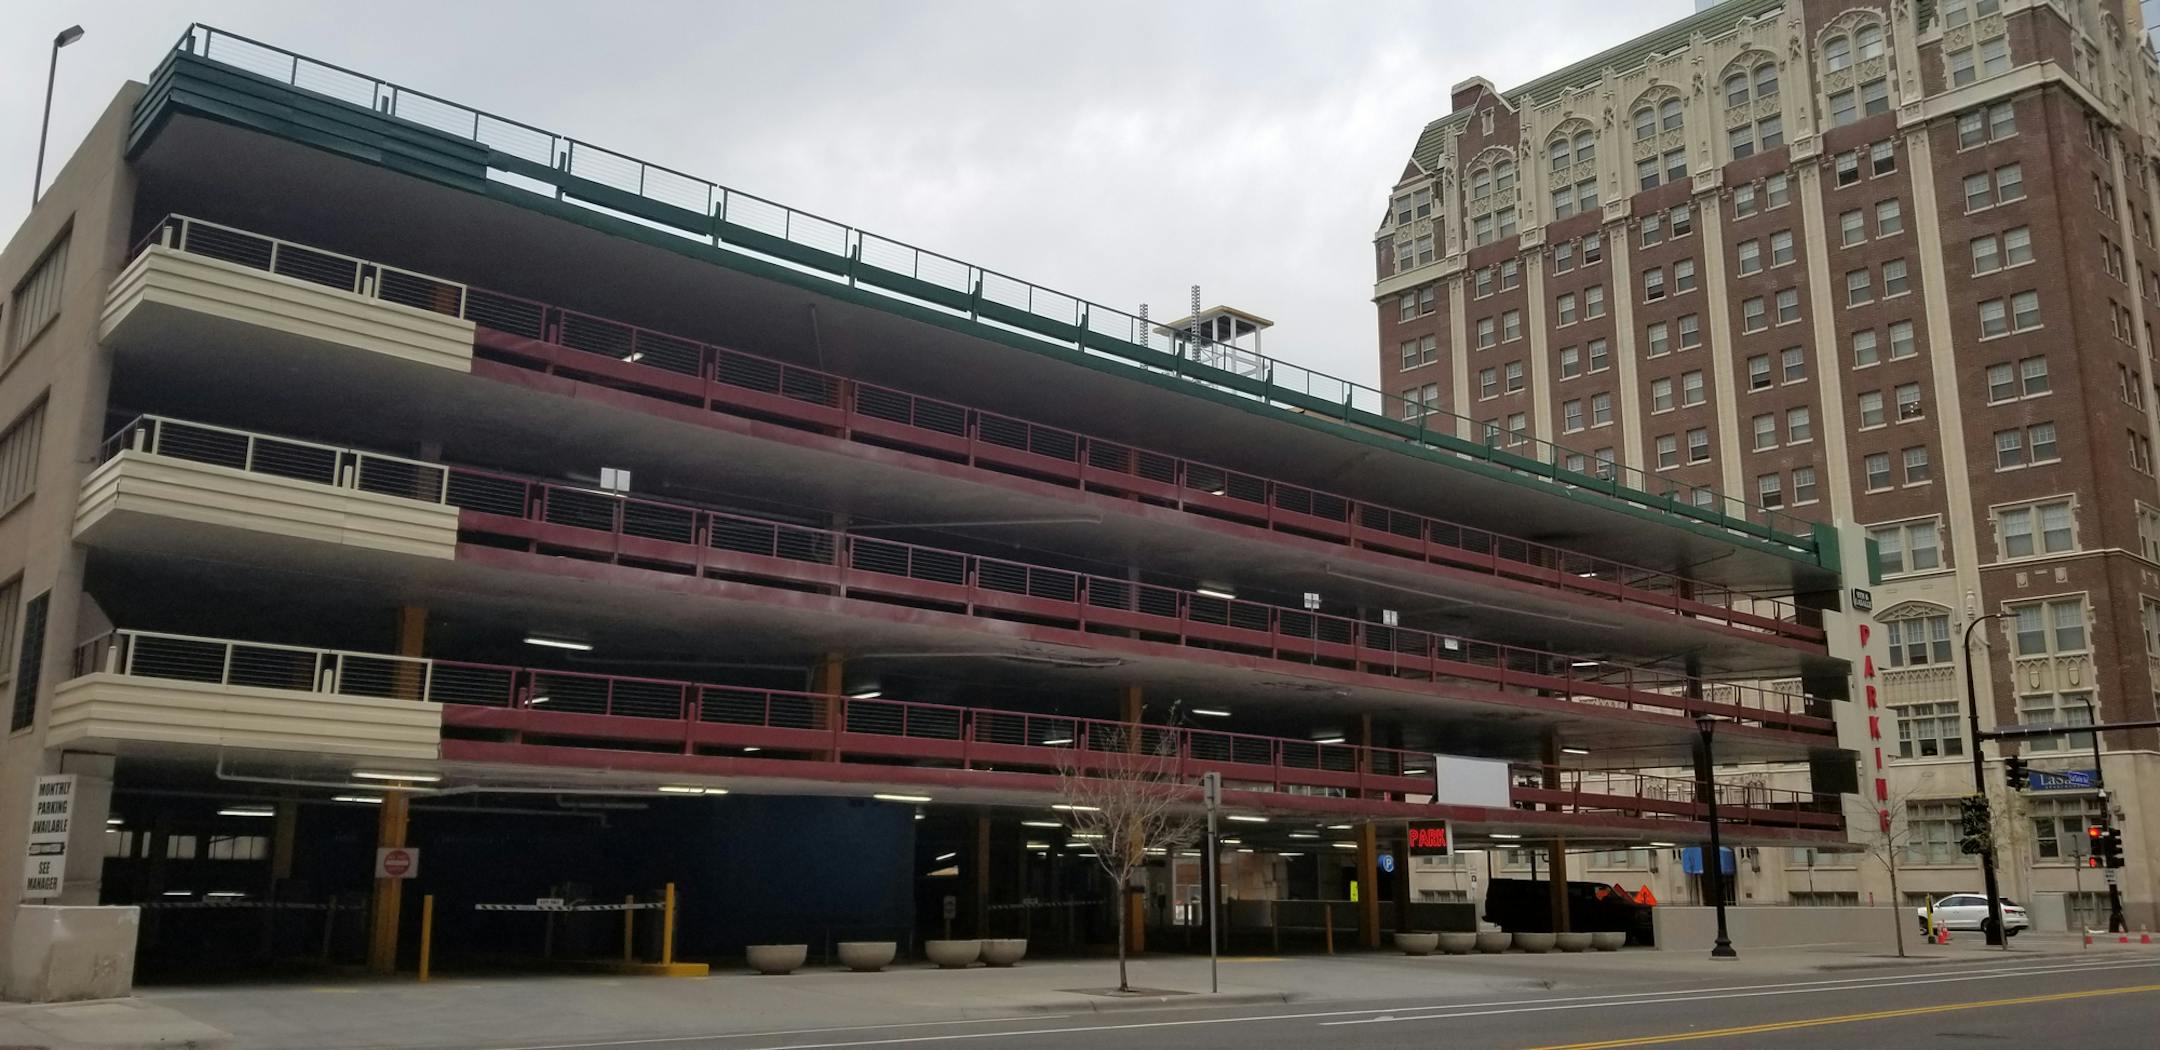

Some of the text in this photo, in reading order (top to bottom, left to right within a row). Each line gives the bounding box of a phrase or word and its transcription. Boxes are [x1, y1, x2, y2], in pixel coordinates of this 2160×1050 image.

[1859, 624, 1890, 833] PARKING
[39, 782, 71, 796] MONTHLY
[37, 800, 68, 815] PARKING
[32, 819, 68, 834] AVAILABLE
[1409, 828, 1447, 848] PARK
[38, 861, 51, 875] SEE
[27, 877, 58, 891] MANAGER
